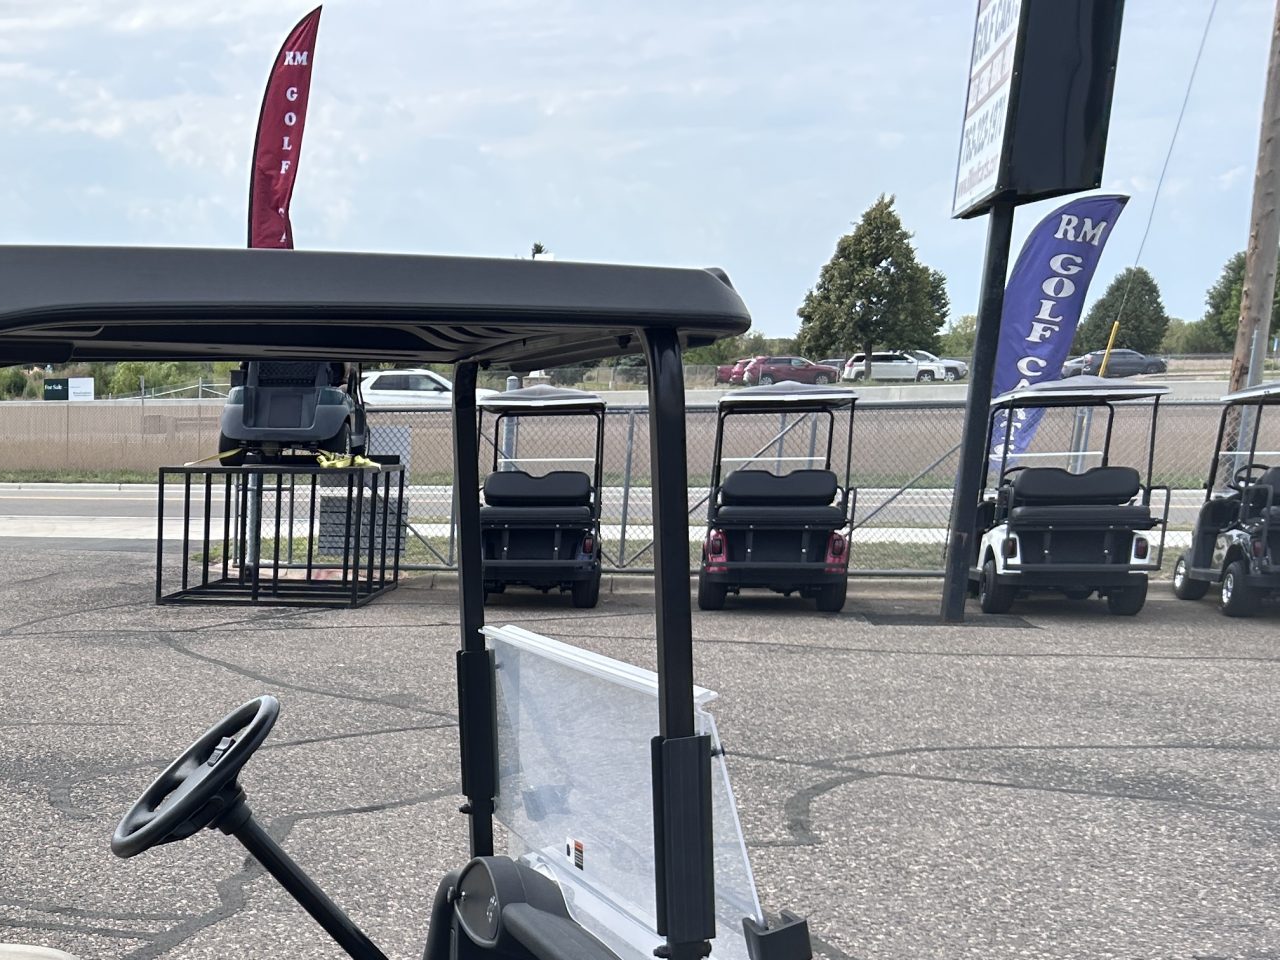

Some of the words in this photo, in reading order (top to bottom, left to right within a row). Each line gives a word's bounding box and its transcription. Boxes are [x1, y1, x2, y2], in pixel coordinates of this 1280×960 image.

[280, 87, 299, 174] GOLF
[1054, 214, 1108, 246] RM
[1025, 253, 1084, 343] GOLF
